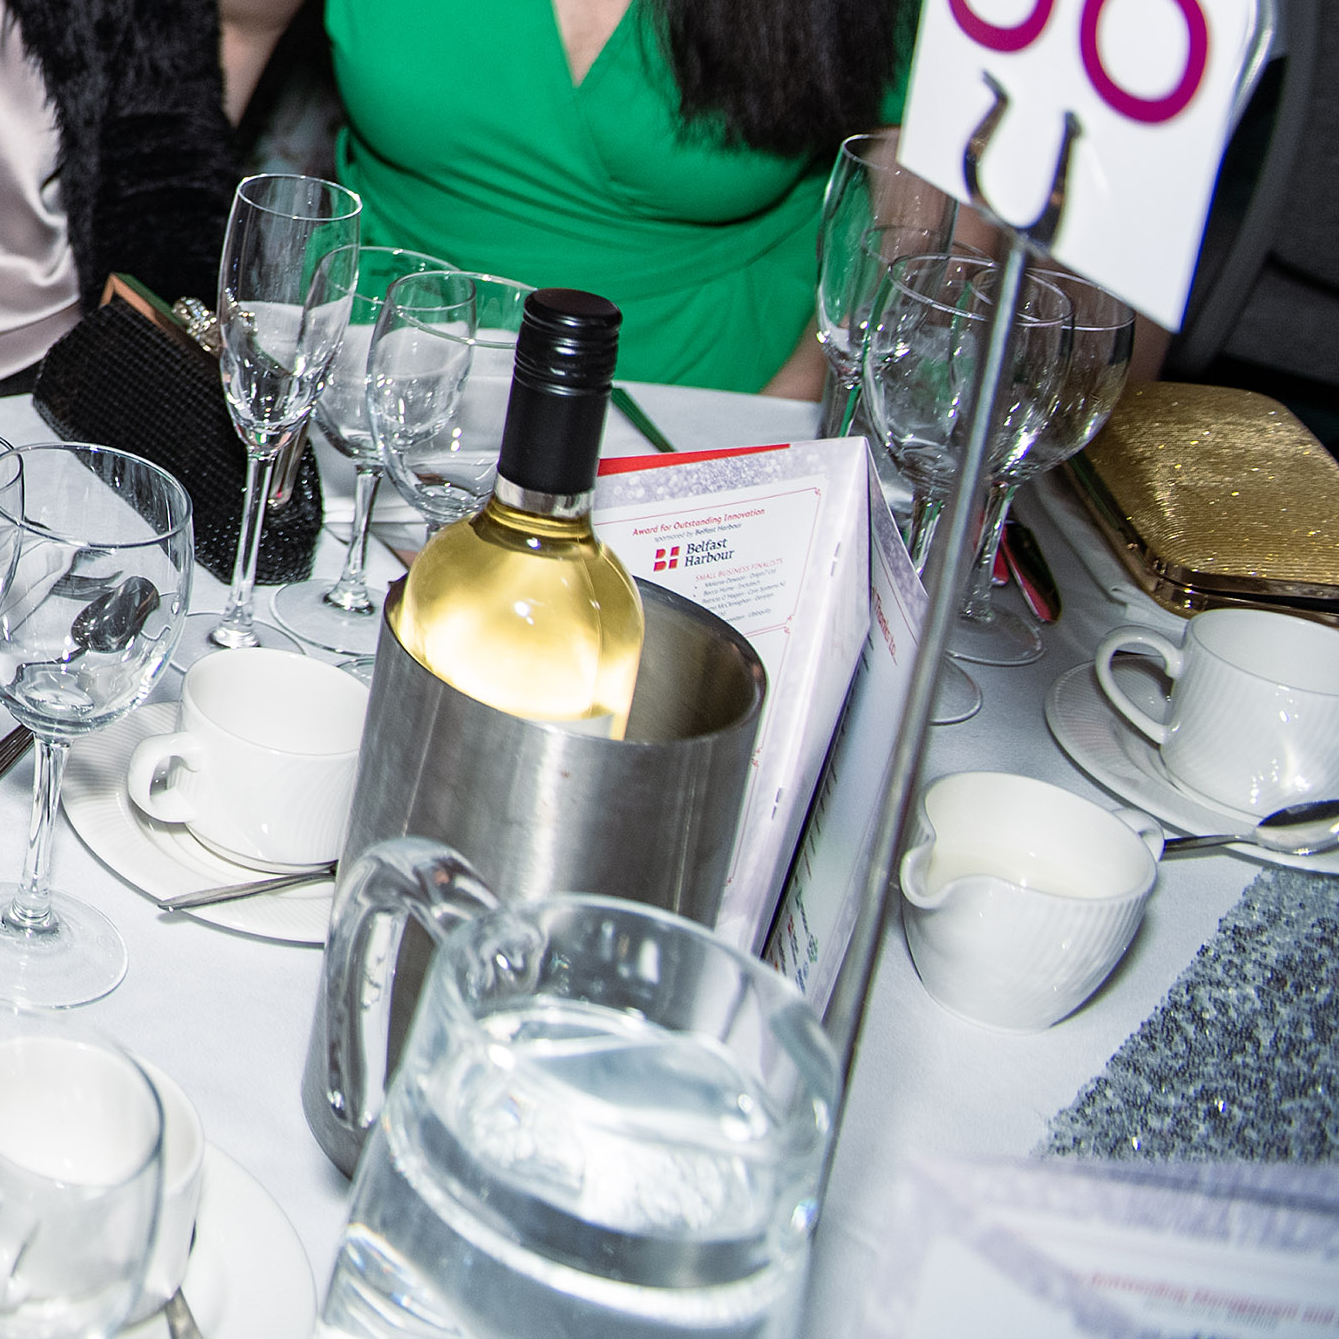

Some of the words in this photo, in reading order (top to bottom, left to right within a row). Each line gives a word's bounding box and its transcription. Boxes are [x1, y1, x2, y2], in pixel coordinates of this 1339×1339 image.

[632, 525, 658, 536] Award
[660, 523, 672, 532] for
[673, 516, 722, 530] Outstanding
[724, 508, 766, 522] Innovation
[686, 538, 728, 555] Belfast
[684, 549, 735, 567] Harbour
